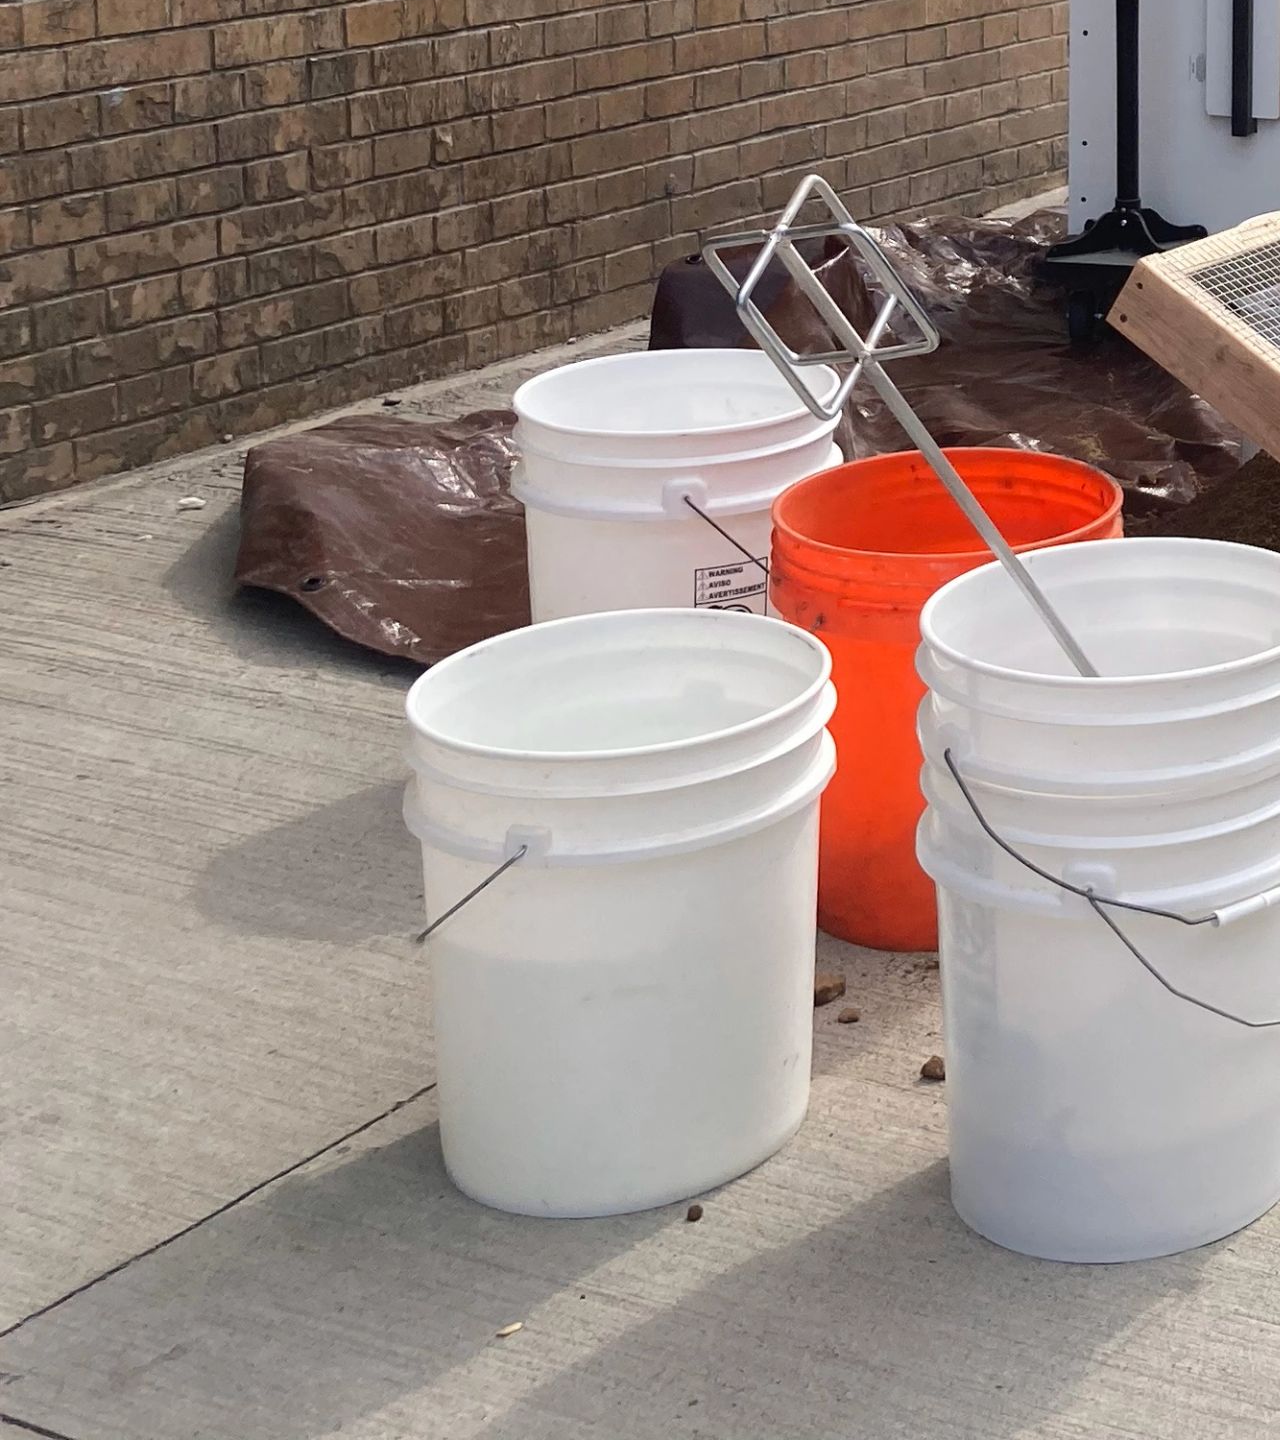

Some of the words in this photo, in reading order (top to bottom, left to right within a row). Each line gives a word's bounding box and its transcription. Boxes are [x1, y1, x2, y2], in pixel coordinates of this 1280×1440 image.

[708, 566, 744, 578] WARNING
[708, 579, 731, 588] AVISO
[708, 581, 766, 599] AVERTISSEMENT
